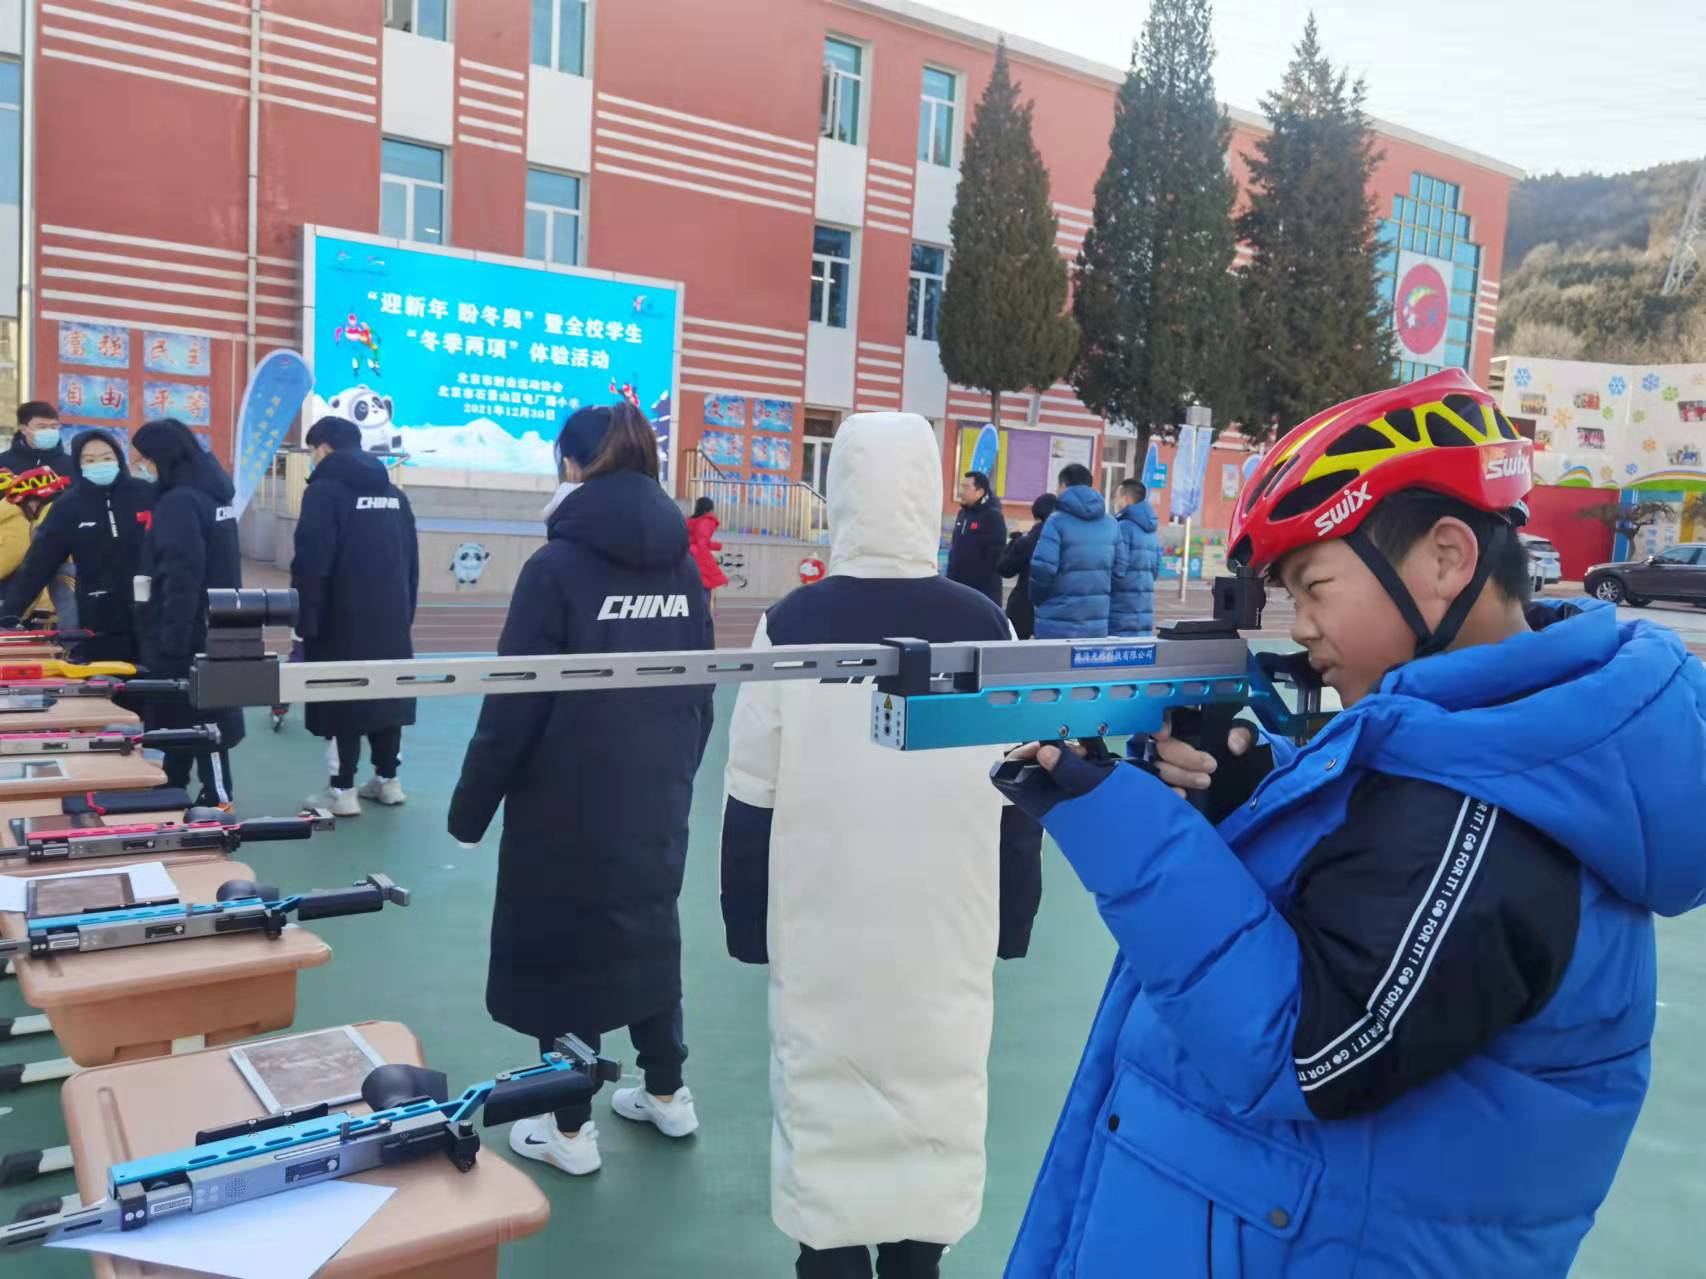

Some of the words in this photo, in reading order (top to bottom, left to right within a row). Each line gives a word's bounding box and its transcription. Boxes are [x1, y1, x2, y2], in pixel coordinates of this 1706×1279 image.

[67, 381, 123, 410] 自由
[149, 387, 206, 418] 平等
[356, 496, 400, 510] CHINA
[597, 594, 690, 621] CHINA
[1451, 851, 1470, 877] FOR
[1417, 917, 1438, 943] FOR
[1383, 984, 1404, 1008] FOR
[1306, 1061, 1332, 1079] FOR
